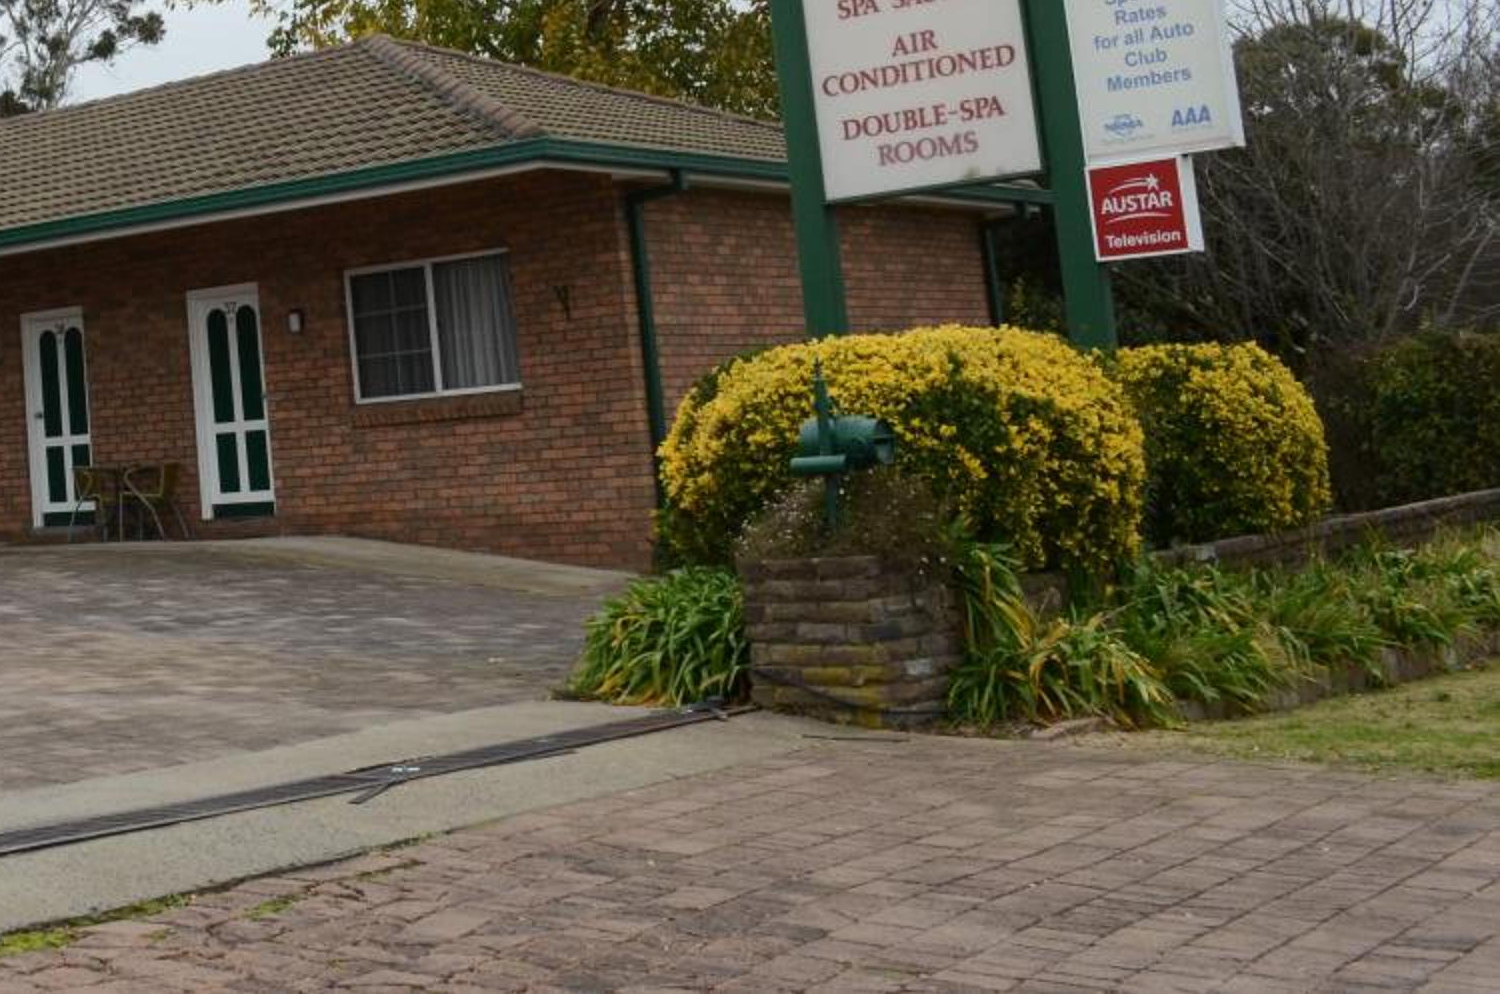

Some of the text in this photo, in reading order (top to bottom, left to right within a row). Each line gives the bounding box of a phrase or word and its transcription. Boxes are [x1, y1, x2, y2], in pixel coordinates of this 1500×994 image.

[1114, 6, 1167, 25] Rates
[892, 29, 938, 57] AIR
[1094, 22, 1194, 51] for all Auto
[1124, 48, 1168, 67] Club
[822, 44, 1015, 97] CONDITIONED
[1107, 68, 1192, 91] Members
[843, 95, 1005, 141] DOUBLE-SPA
[1172, 104, 1211, 126] AAA
[878, 130, 979, 166] ROOMS
[1101, 190, 1172, 215] AUSTAR
[1106, 229, 1180, 249] Television
